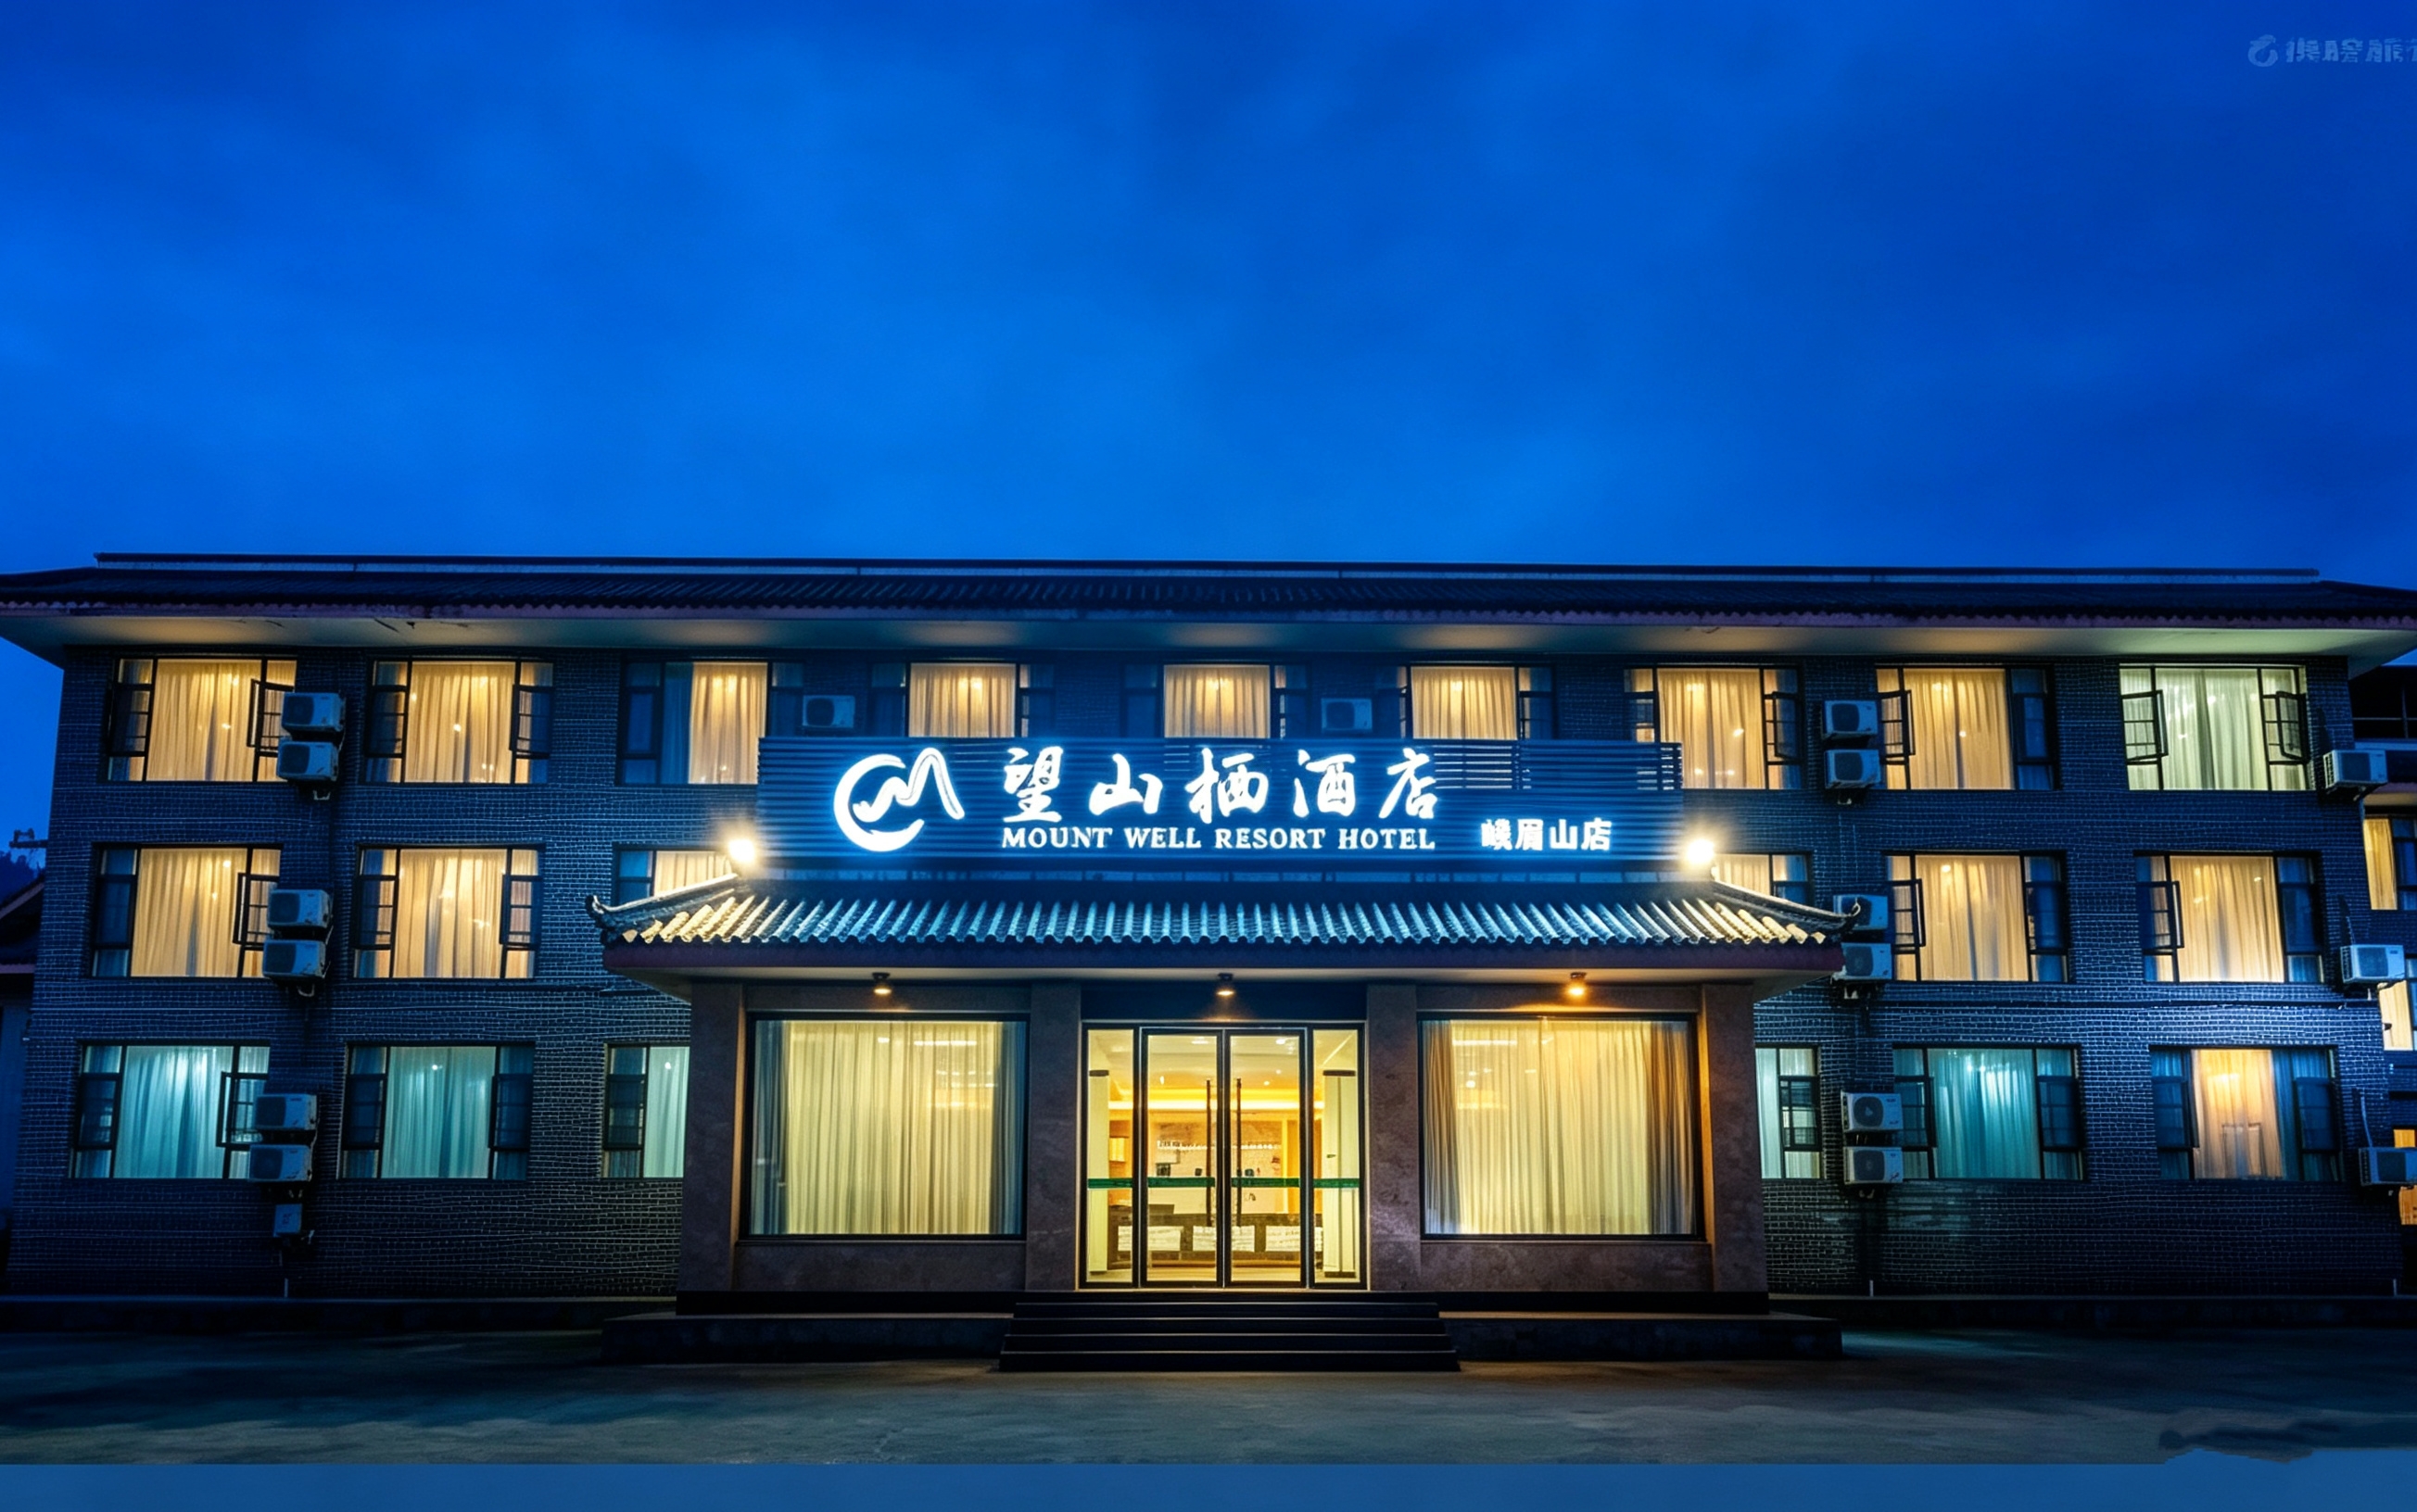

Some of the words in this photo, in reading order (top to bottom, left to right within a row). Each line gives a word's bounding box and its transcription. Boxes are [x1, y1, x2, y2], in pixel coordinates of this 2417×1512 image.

[1002, 744, 1436, 825] 望山栖酒店
[1001, 826, 1114, 850] MOUNT
[1123, 826, 1203, 850] WELL
[1214, 826, 1326, 850] RESORT
[1337, 827, 1436, 850] HOTEL
[1480, 817, 1613, 852] 峨眉山店
